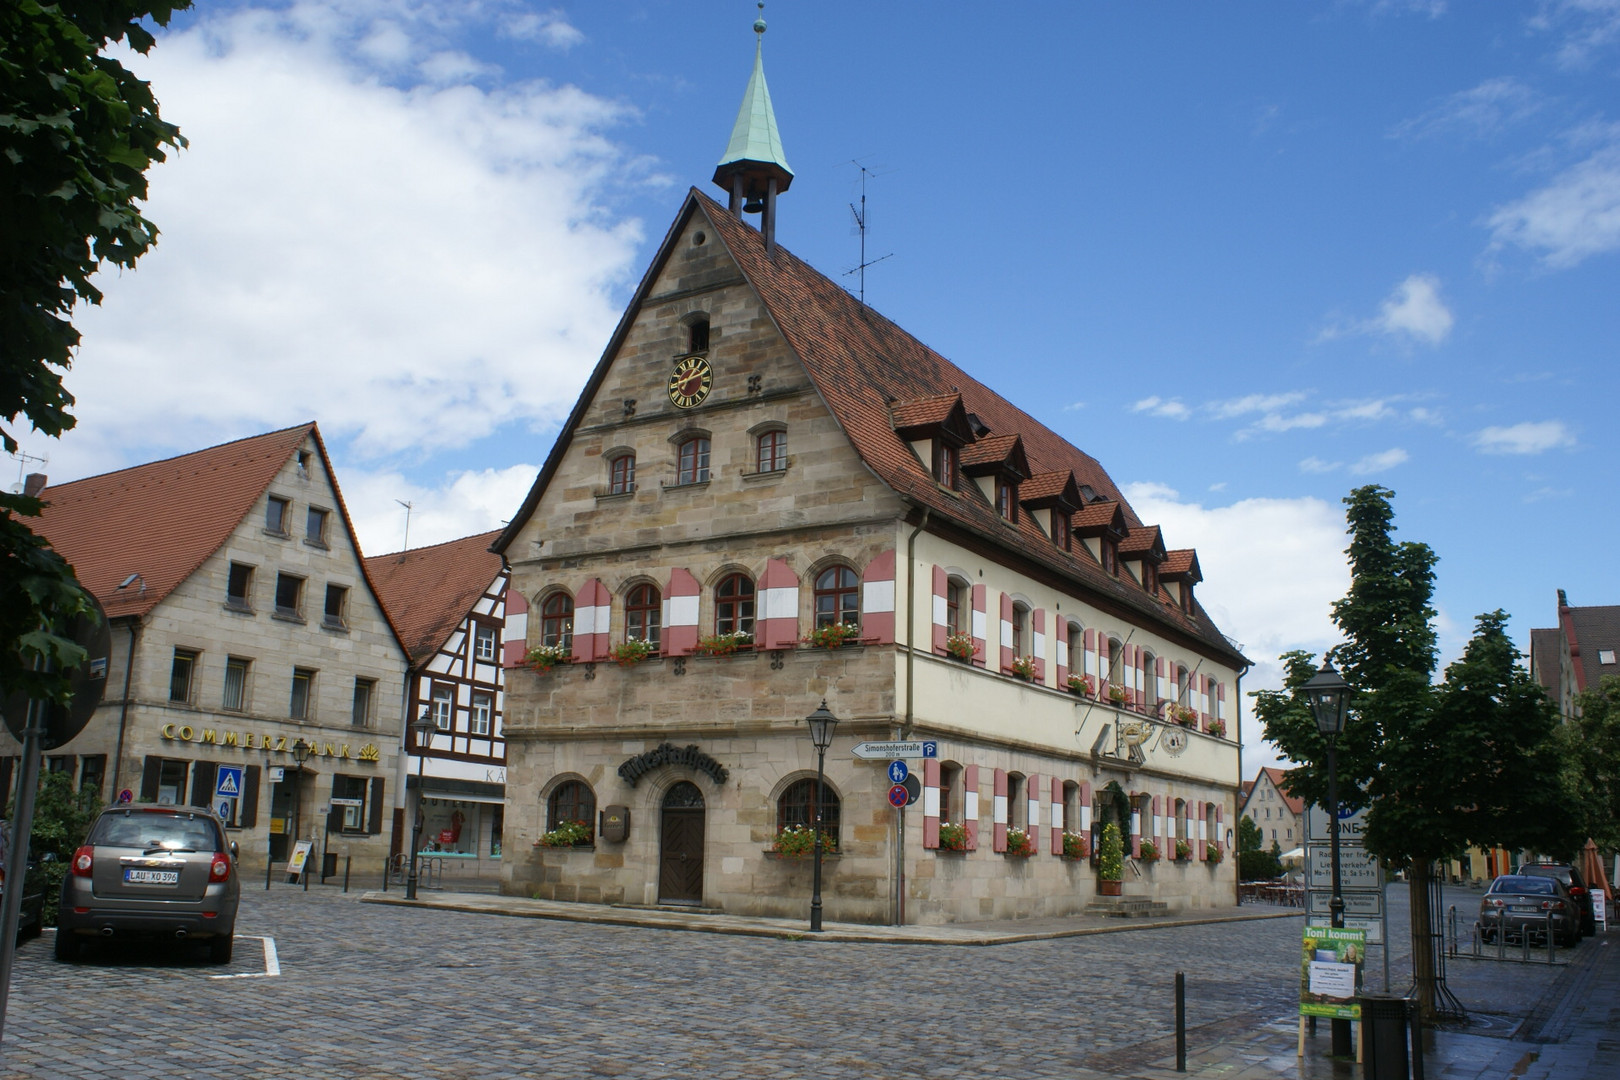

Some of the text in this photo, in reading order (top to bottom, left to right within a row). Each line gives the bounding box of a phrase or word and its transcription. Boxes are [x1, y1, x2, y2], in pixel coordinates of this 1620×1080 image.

[161, 723, 351, 757] COMMERZANK
[865, 743, 920, 752] Simonshoferstraße
[658, 743, 729, 784] Rathaus
[1306, 928, 1326, 938] Toni
[1328, 929, 1364, 940] kommt
